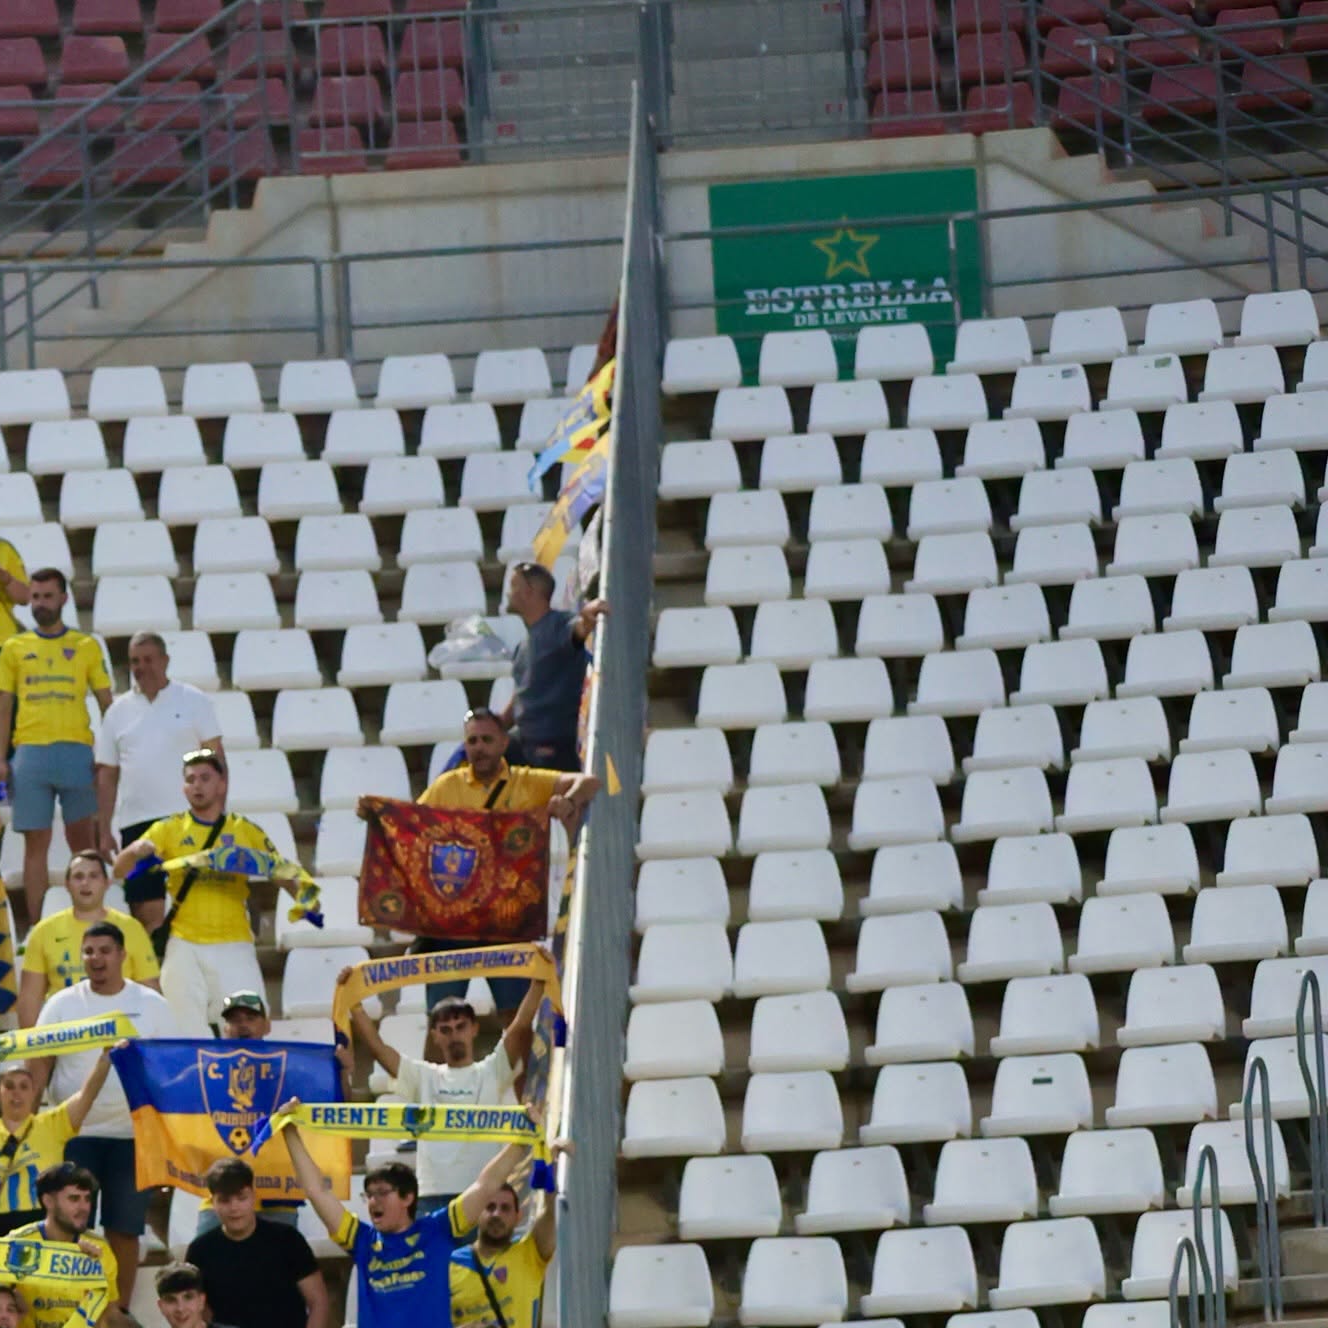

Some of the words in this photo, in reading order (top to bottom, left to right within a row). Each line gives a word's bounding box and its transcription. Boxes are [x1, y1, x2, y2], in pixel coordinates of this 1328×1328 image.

[745, 277, 953, 316] ESTRELLA
[794, 313, 819, 327] DE
[823, 307, 908, 324] LEVANTE
[26, 1020, 116, 1047] ESKORPION
[312, 1107, 388, 1126] FRENTE
[445, 1109, 536, 1132] ESKORPION
